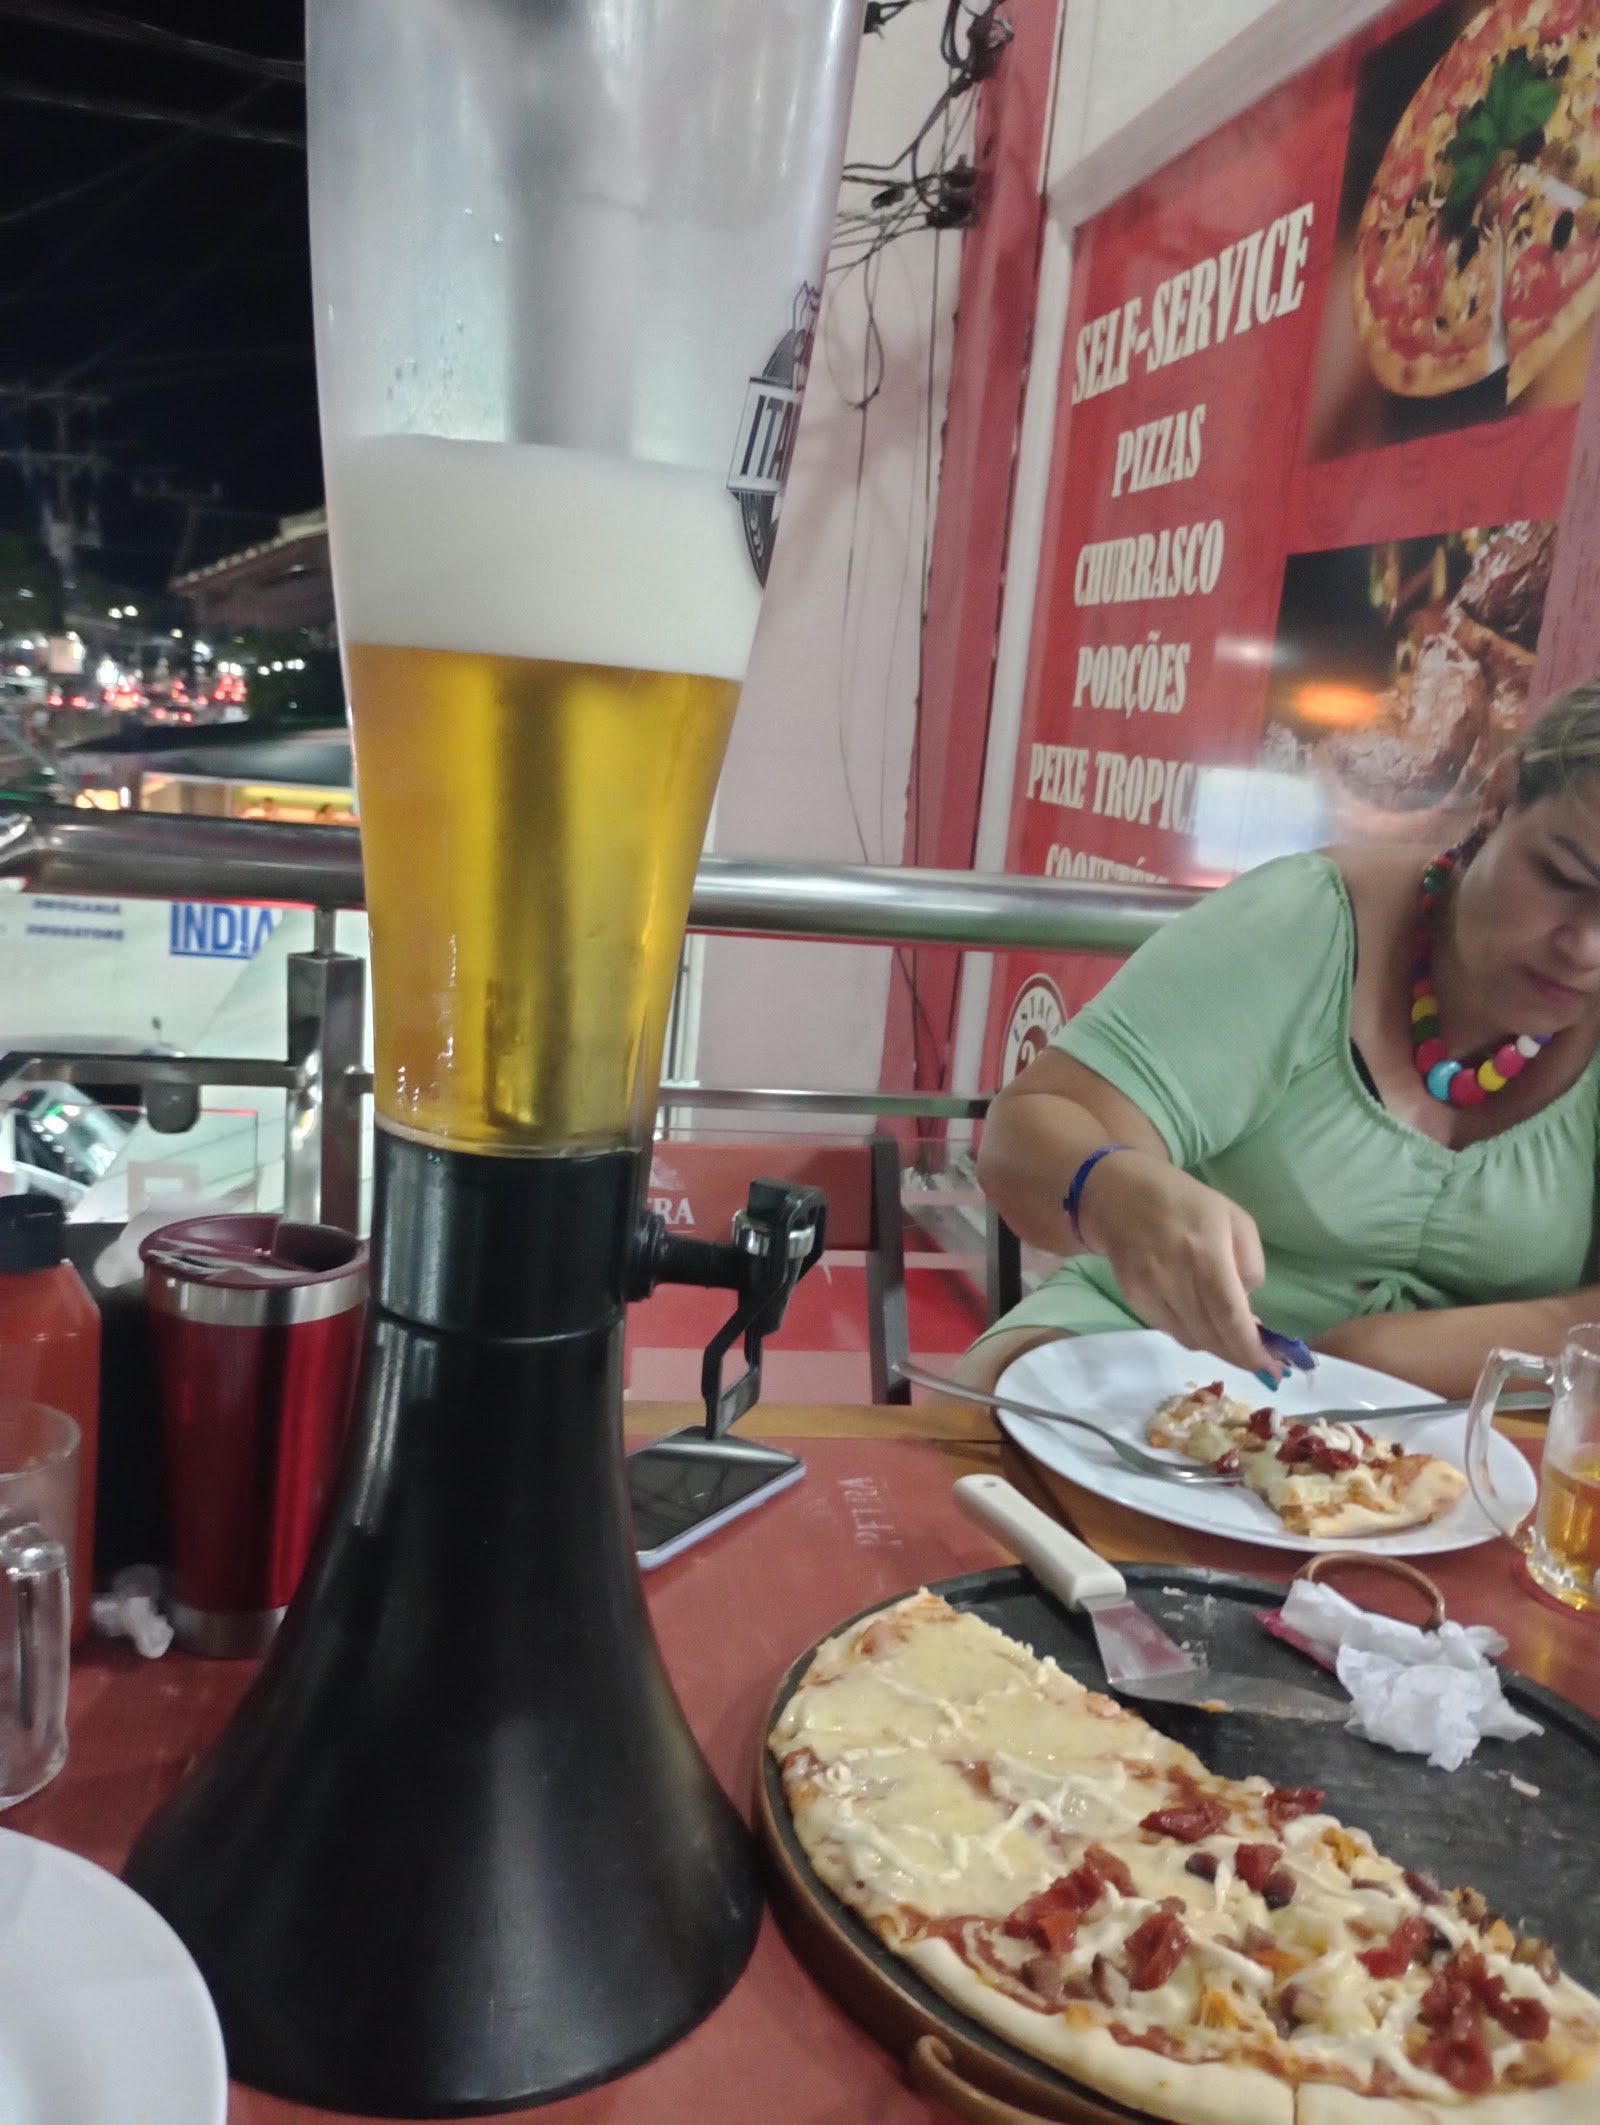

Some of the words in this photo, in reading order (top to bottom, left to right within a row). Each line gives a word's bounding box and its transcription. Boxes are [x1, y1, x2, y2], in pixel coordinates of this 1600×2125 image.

[1071, 202, 1314, 405] SELF-SERVICE
[1111, 403, 1206, 498] PIZZAS
[1073, 518, 1224, 607] CHURRASCO
[1072, 631, 1191, 719] PORÇÕES
[1026, 743, 1089, 809] PEIXE
